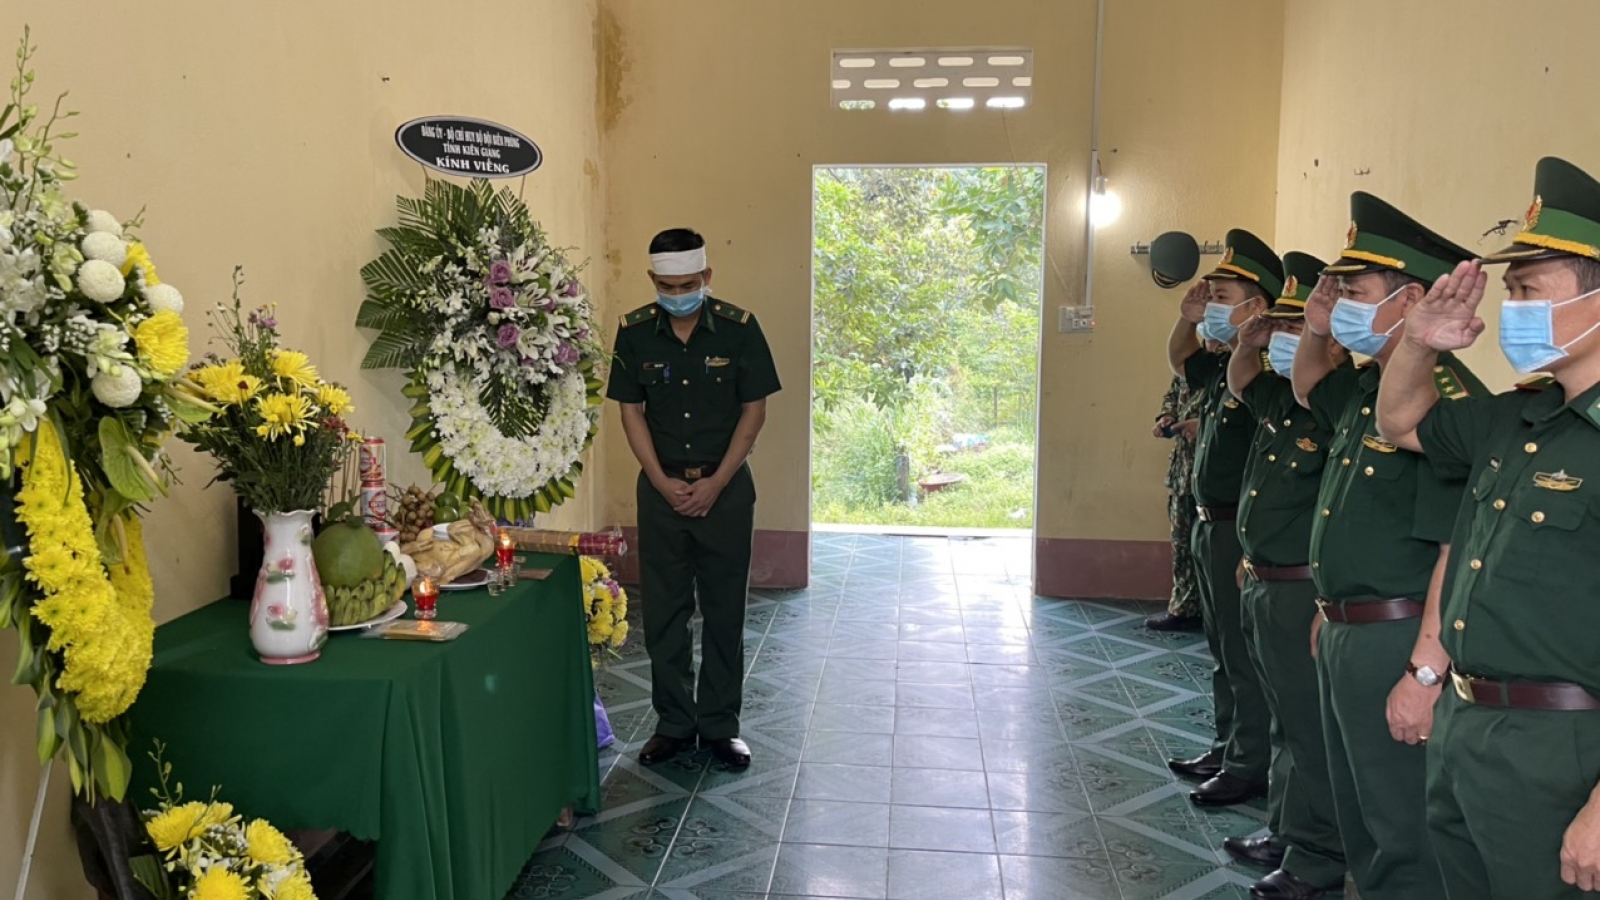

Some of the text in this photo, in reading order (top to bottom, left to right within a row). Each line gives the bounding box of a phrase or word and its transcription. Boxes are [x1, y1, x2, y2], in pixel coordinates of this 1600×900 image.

[443, 141, 501, 159] TỈNH KIÊN GIANG
[436, 155, 510, 174] KÍNH VIẾNG
